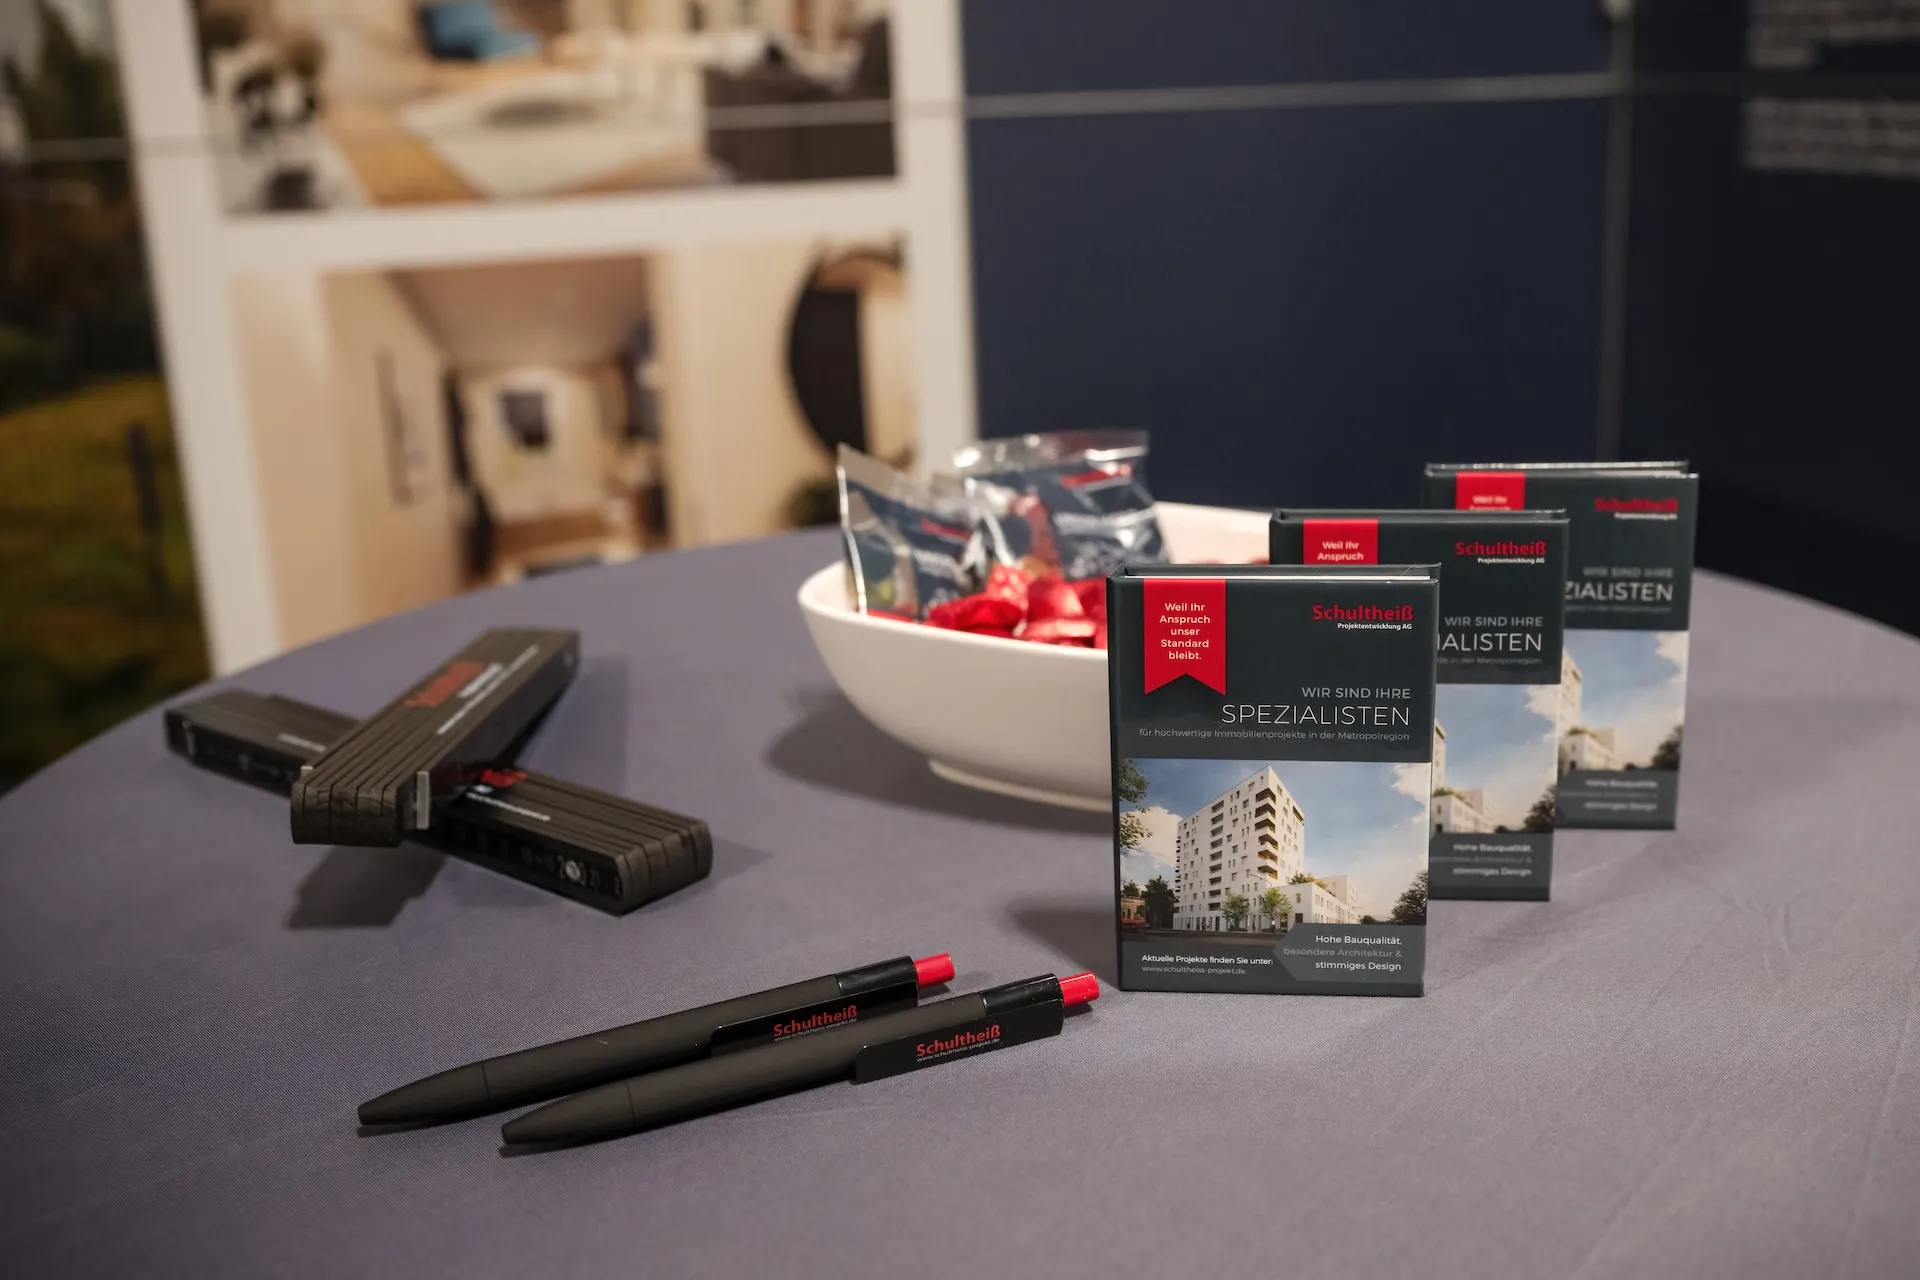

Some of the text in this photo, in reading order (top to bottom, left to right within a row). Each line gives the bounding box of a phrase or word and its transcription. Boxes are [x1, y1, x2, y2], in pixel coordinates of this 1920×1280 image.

[1322, 541, 1359, 549] Weil Ihr
[1455, 541, 1546, 556] Schultheiß
[1317, 552, 1364, 562] Anspruch
[1564, 581, 1674, 601] ZIALISTEN
[1164, 602, 1205, 612] Weil Ihr
[1312, 604, 1413, 620] Schultheiß
[1159, 614, 1211, 625] Anspruch
[1444, 616, 1543, 627] WIR SIND IHRE
[1170, 627, 1200, 636] unser
[1337, 622, 1401, 631] Projektentwicklung
[1160, 639, 1210, 648] Standard
[1437, 633, 1542, 651] IALISTEN
[1168, 651, 1202, 660] bleibt.
[1301, 687, 1411, 699] WIR SIND IHRE
[1221, 704, 1409, 726] SPEZIALISTEN
[1139, 728, 1410, 742] für hochwertige Immobilienprojekte in der Metropolregion
[1315, 935, 1403, 946] Hohe Bauqualität,
[1283, 947, 1403, 958] besondere Architektur &
[1141, 954, 1274, 965] Aktuelle Projekte finden Sie unter:
[1141, 965, 1247, 975] www.schultheiss-projekt.de
[1315, 960, 1402, 972] stimmiges Design
[773, 1004, 858, 1037] Schultheiß
[916, 1024, 1001, 1057] Schultheiß
